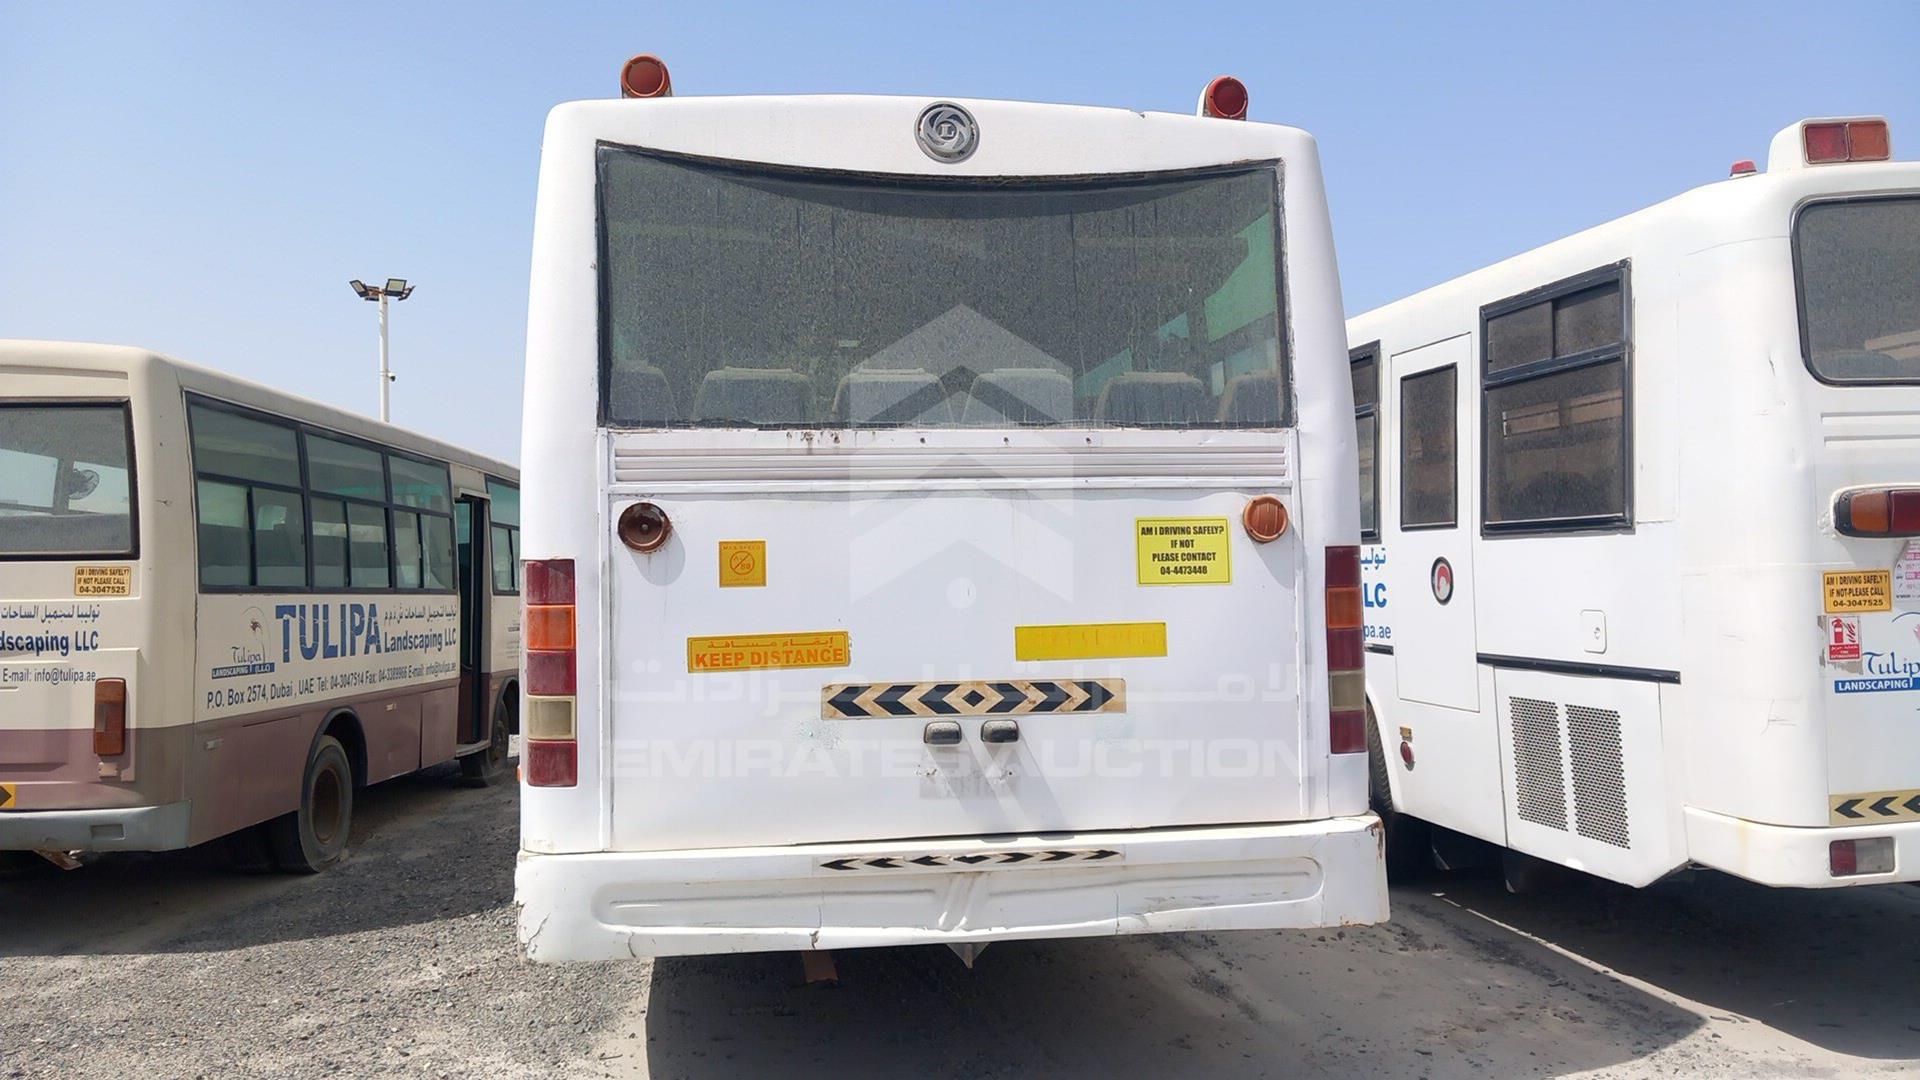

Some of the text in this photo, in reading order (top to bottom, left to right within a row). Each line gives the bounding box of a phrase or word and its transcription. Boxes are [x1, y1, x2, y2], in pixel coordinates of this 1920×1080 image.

[1141, 526, 1153, 536] AM
[1159, 526, 1191, 535] DRIVING
[1193, 525, 1225, 535] SAFELY?
[1171, 539, 1195, 548] IF NOT
[1152, 552, 1216, 562] PLEASE CONTACT
[77, 568, 85, 576] AM
[1160, 565, 1208, 575] 04-4473448
[1826, 576, 1835, 586] AM
[1839, 575, 1862, 585] DRIVING
[79, 585, 126, 593] 04-3047525
[1829, 588, 1835, 597] IF
[1870, 587, 1884, 596] CALL
[1833, 599, 1884, 607] 04-3047525
[275, 603, 382, 663] TULIPA
[75, 630, 99, 651] LLC
[384, 627, 457, 654] Landscaping LLC
[695, 648, 844, 668] KEEP DISTANCE
[1862, 651, 1920, 678] Tulip
[3, 667, 96, 685] E-mail: info@tulipa.ae
[212, 666, 249, 678] LANDSCAPING
[1838, 679, 1908, 691] LANDSCAPING
[207, 690, 225, 709] P.O.
[227, 689, 245, 706] Box
[247, 685, 269, 703] 2574,
[299, 678, 314, 695] UAE
[317, 676, 329, 692] Tel:
